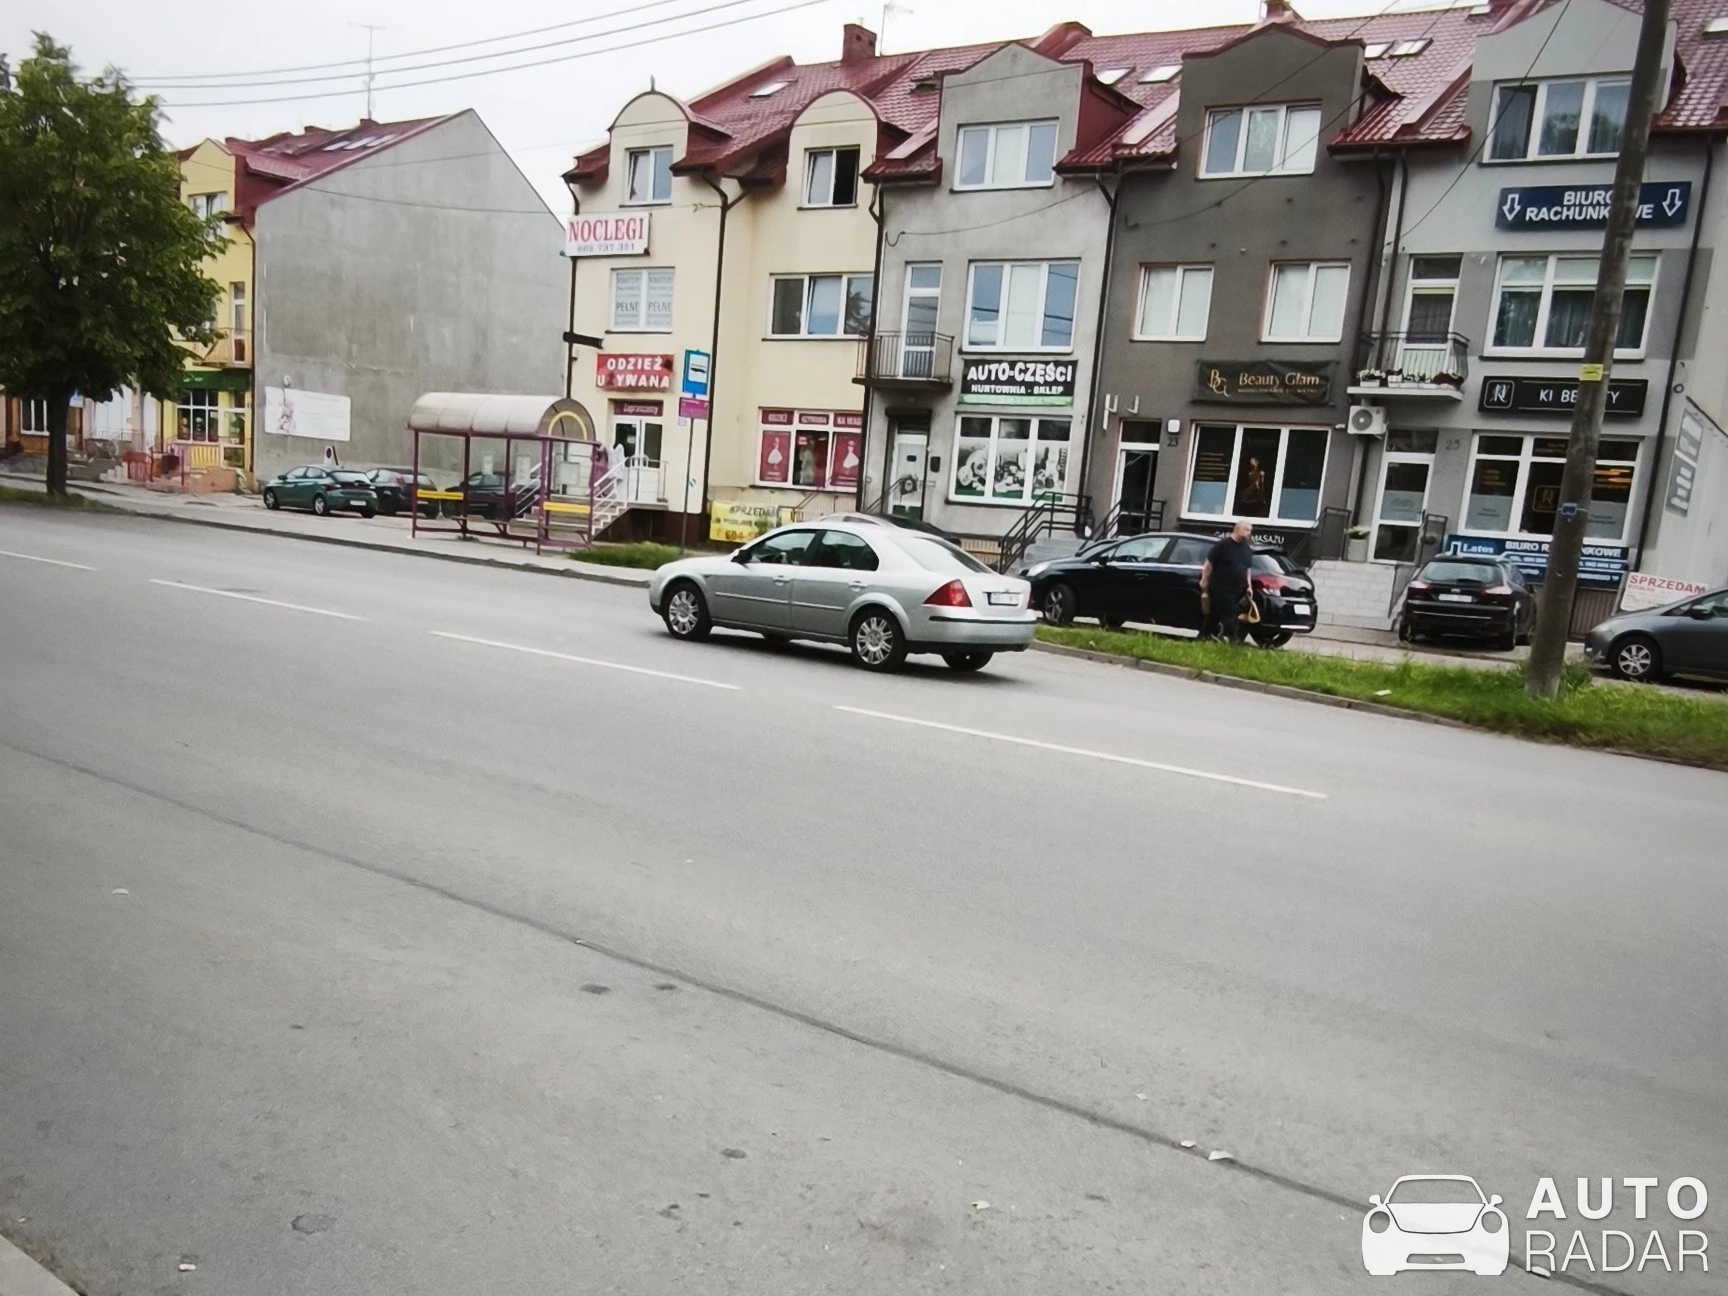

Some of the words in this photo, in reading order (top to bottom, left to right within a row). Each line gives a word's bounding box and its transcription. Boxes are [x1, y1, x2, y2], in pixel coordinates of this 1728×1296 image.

[1525, 204, 1654, 221] RACHUNKE
[569, 218, 644, 242] NOCLEGI
[607, 356, 663, 371] ODZIEŻ
[967, 362, 1072, 384] AUTO-CZĘŚCI
[1239, 372, 1279, 387] Beauty
[1285, 372, 1319, 386] Glam
[1033, 386, 1063, 395] SKLEP
[1561, 390, 1620, 403] BEY
[1167, 437, 1179, 447] 23
[1505, 541, 1539, 551] BIURO
[1629, 574, 1706, 594] SPRZEDAM
